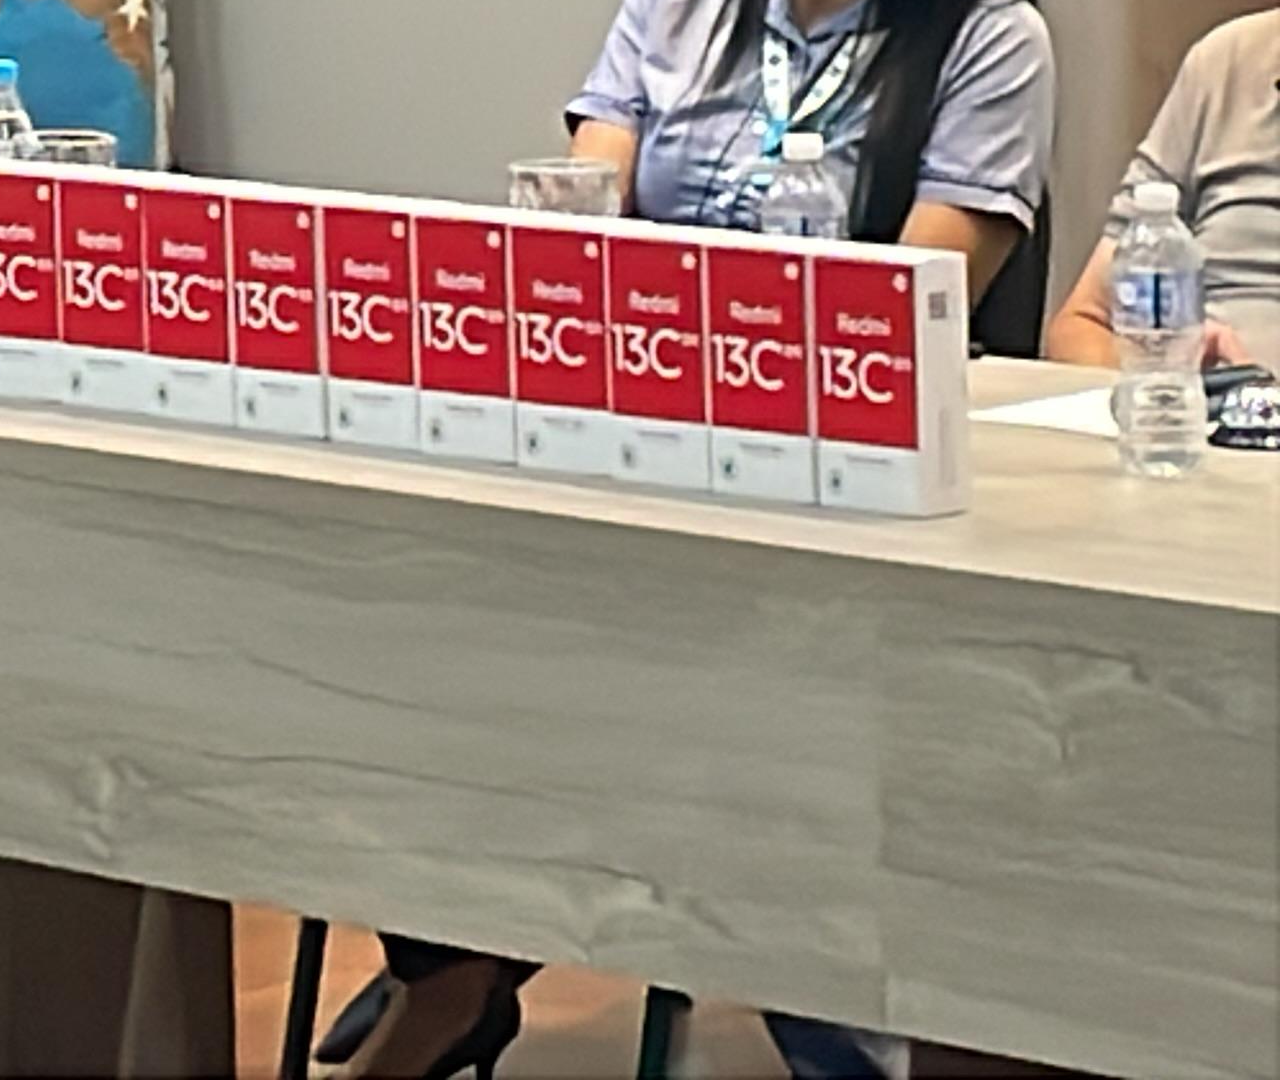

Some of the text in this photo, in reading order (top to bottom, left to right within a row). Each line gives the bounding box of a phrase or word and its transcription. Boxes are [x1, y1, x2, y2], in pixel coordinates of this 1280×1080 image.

[63, 261, 126, 311] 13C
[149, 270, 210, 321] 13C
[235, 281, 299, 333] 13C
[328, 291, 393, 343] 13C
[420, 302, 488, 355] 13C
[515, 313, 587, 367] 13C
[837, 312, 891, 336] Redmi
[612, 324, 682, 379] 13C
[712, 334, 784, 391] 13C
[819, 345, 894, 403] 13C
